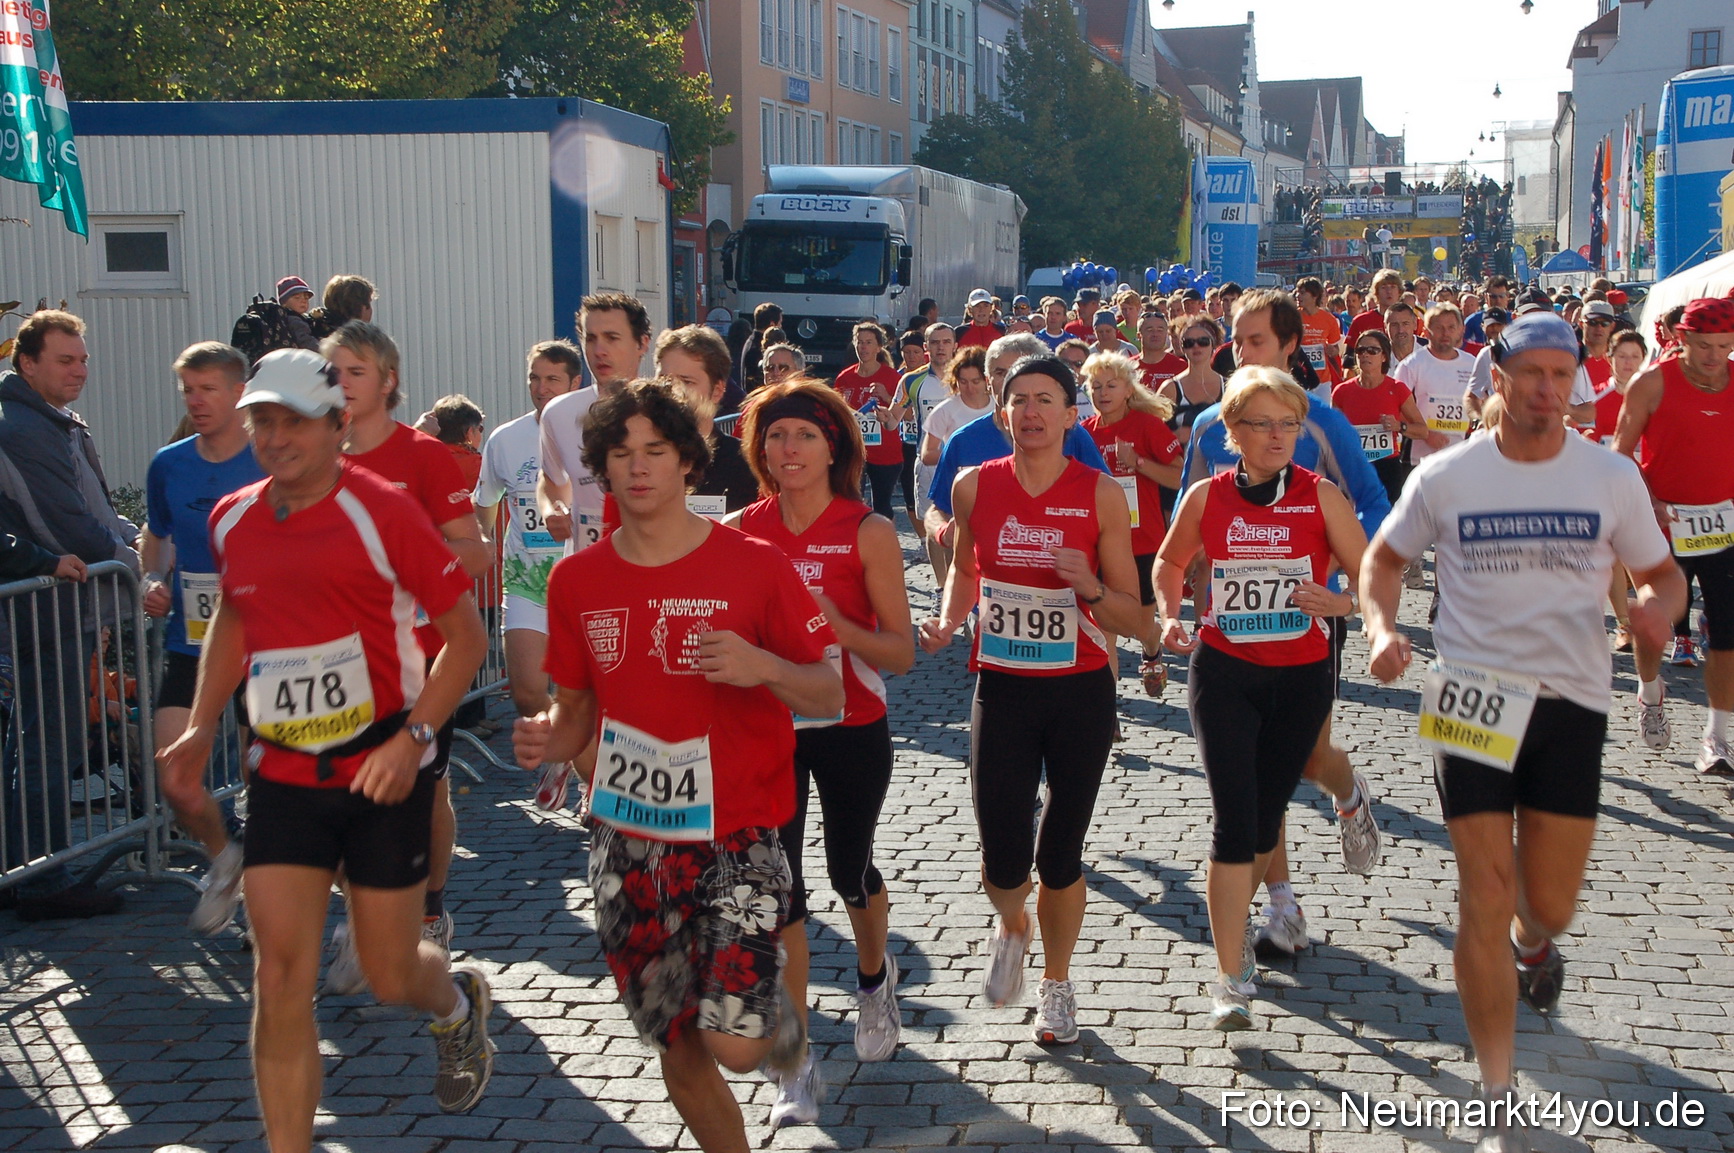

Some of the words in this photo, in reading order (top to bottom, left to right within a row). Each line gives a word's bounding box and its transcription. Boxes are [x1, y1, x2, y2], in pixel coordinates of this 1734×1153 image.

[1684, 94, 1734, 128] ma
[781, 198, 851, 212] BOCK
[1221, 206, 1240, 221] dsl
[1344, 203, 1394, 213] BOCK
[1436, 405, 1463, 419] 323
[1478, 516, 1591, 536] STAEDTLER
[1685, 514, 1726, 535] 104
[1018, 527, 1060, 549] Helpi
[1245, 527, 1287, 544] Helpi
[1685, 533, 1733, 548] Gerhard
[1225, 566, 1268, 574] PFLEIDERER
[993, 588, 1032, 601] PFLEIDERER
[1224, 579, 1300, 611] 2672
[198, 593, 219, 619] 8
[648, 600, 660, 608] 11.
[662, 599, 728, 610] NEUMARKTER
[659, 608, 713, 617] STADTLAUF
[587, 618, 619, 629] IMMER
[989, 603, 1065, 640] 3198
[1217, 613, 1272, 631] Goretti
[1280, 612, 1309, 629] Ma-
[1009, 640, 1042, 658] Irmi
[275, 671, 347, 715] 478
[1438, 680, 1505, 726] 698
[273, 707, 360, 744] Berthold
[1433, 716, 1492, 749] Rainer
[607, 753, 698, 804] 2294
[615, 796, 686, 827] Florian
